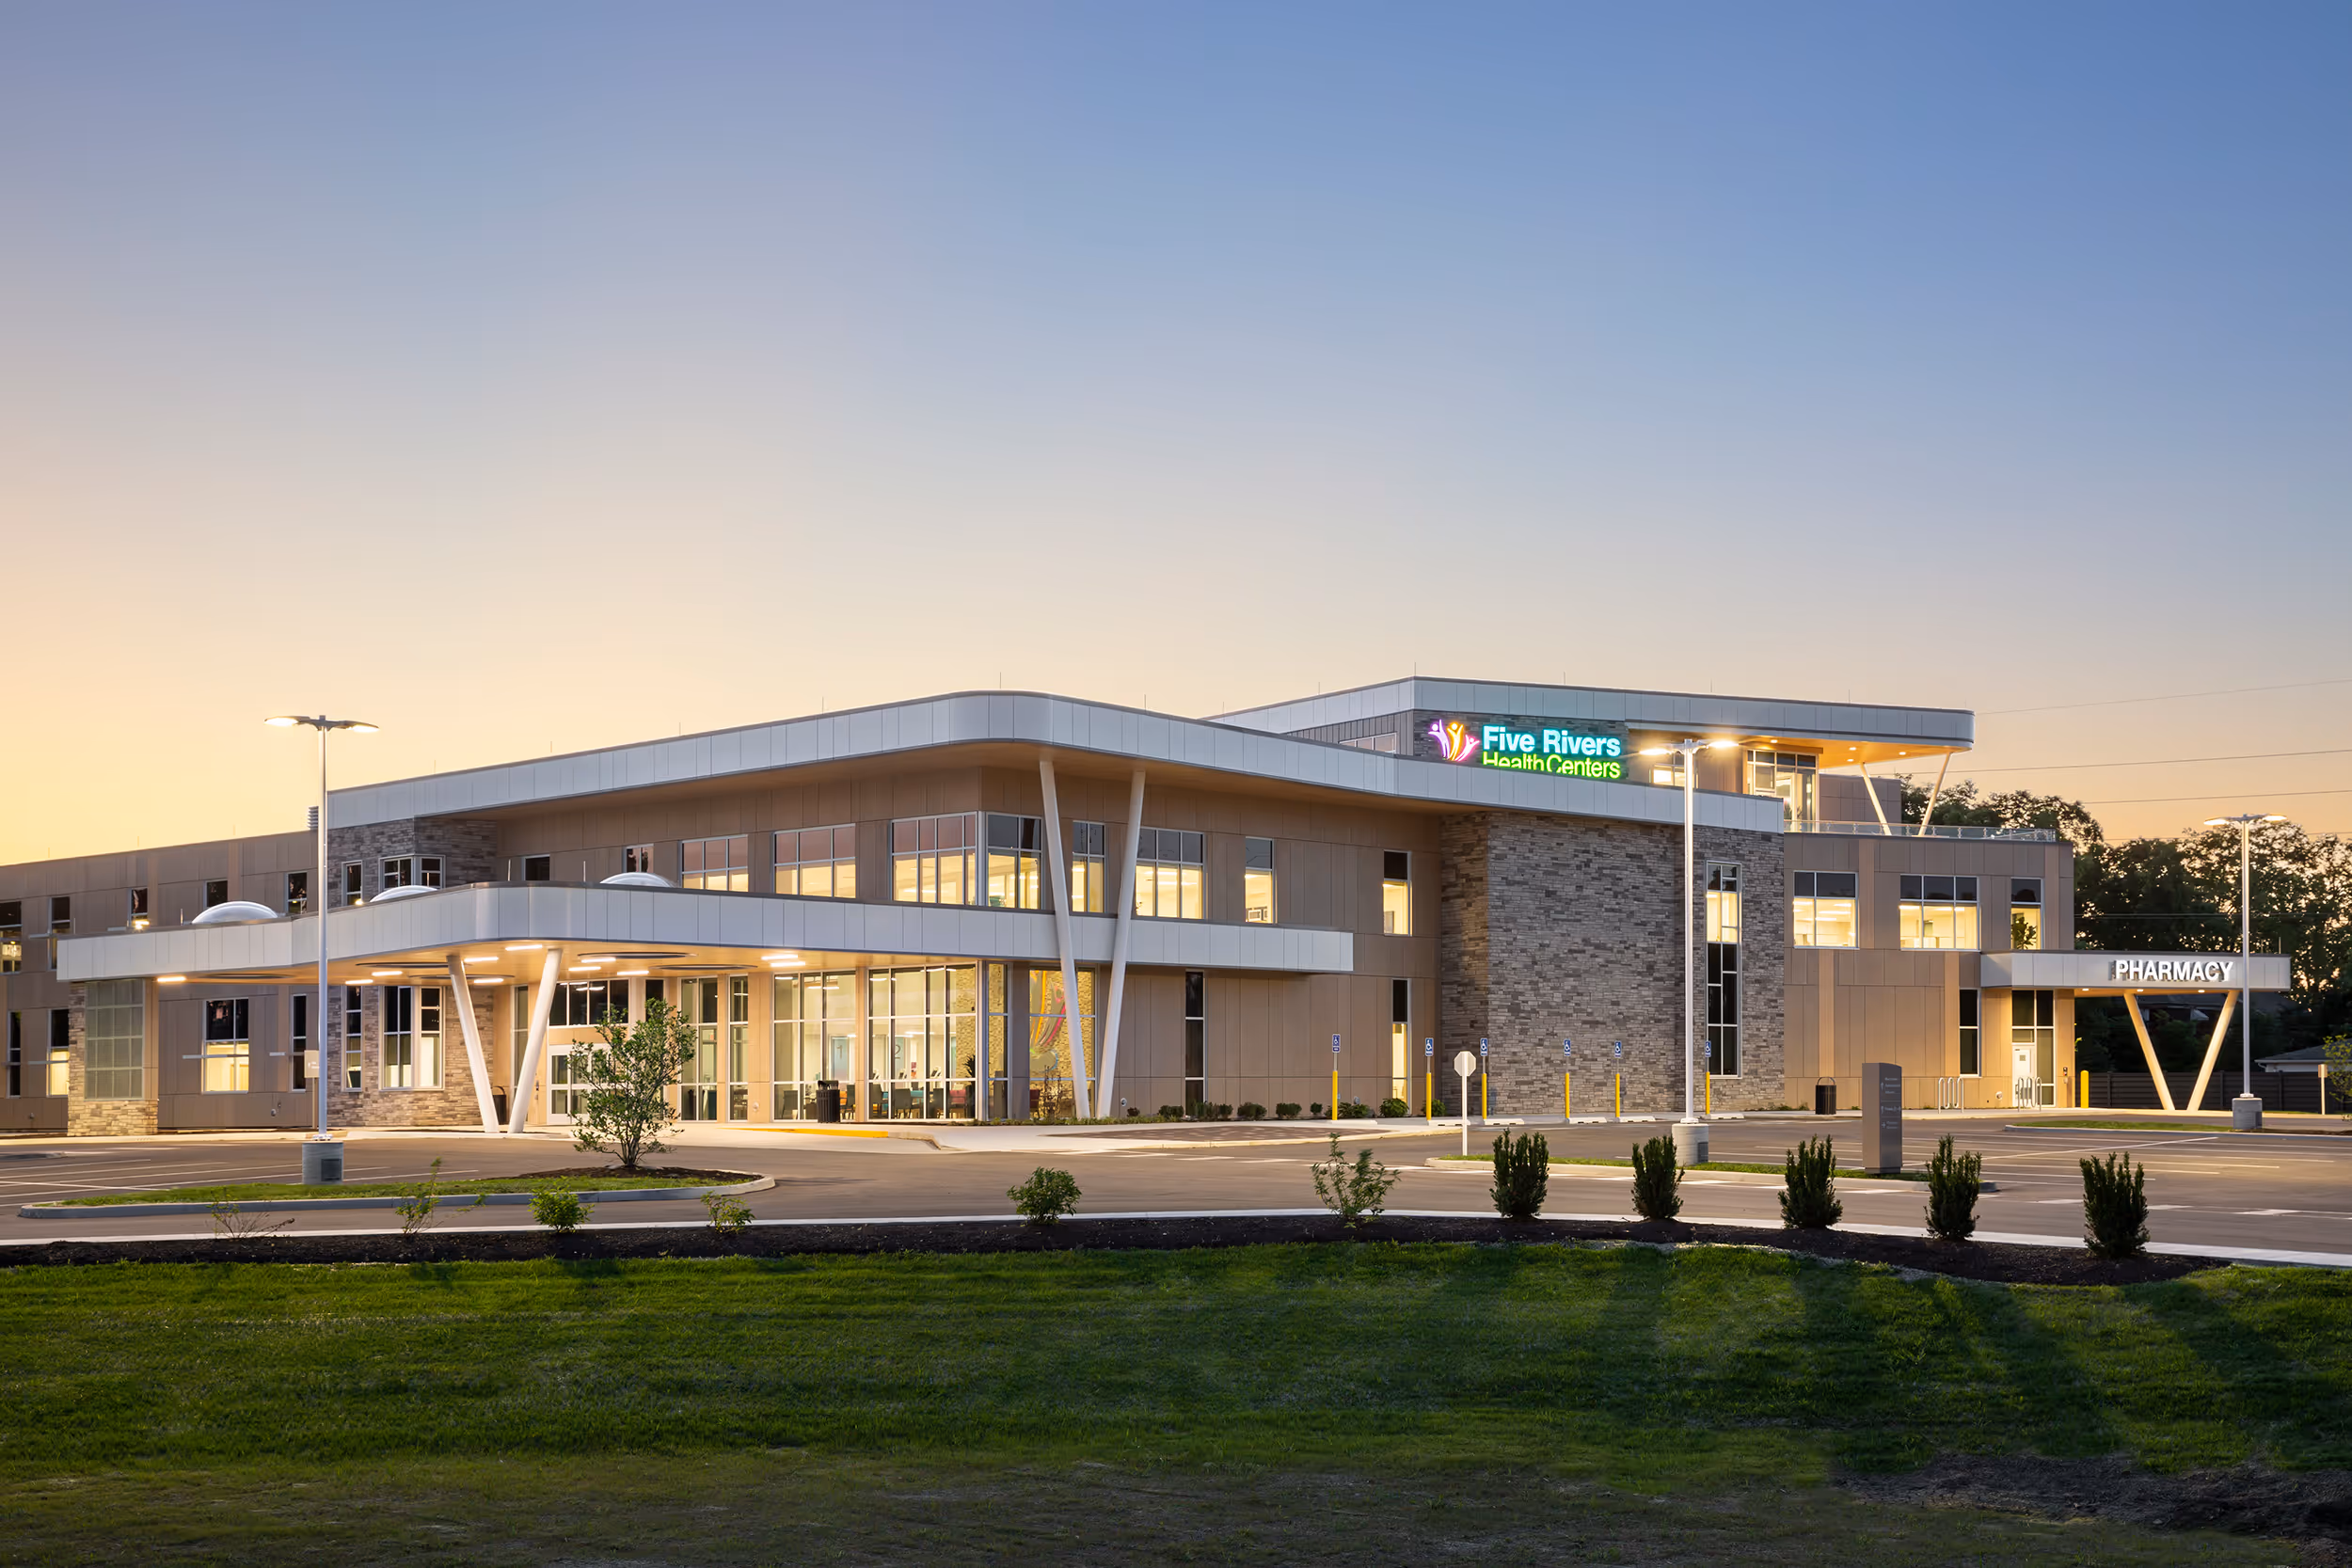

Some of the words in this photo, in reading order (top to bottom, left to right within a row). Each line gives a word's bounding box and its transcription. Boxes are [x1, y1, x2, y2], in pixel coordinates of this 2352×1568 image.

[1483, 725, 1534, 752] Five
[1543, 729, 1621, 757] Rivers
[1483, 752, 1545, 771] Health
[1547, 754, 1621, 779] Centers
[2115, 959, 2233, 981] PHARMACY
